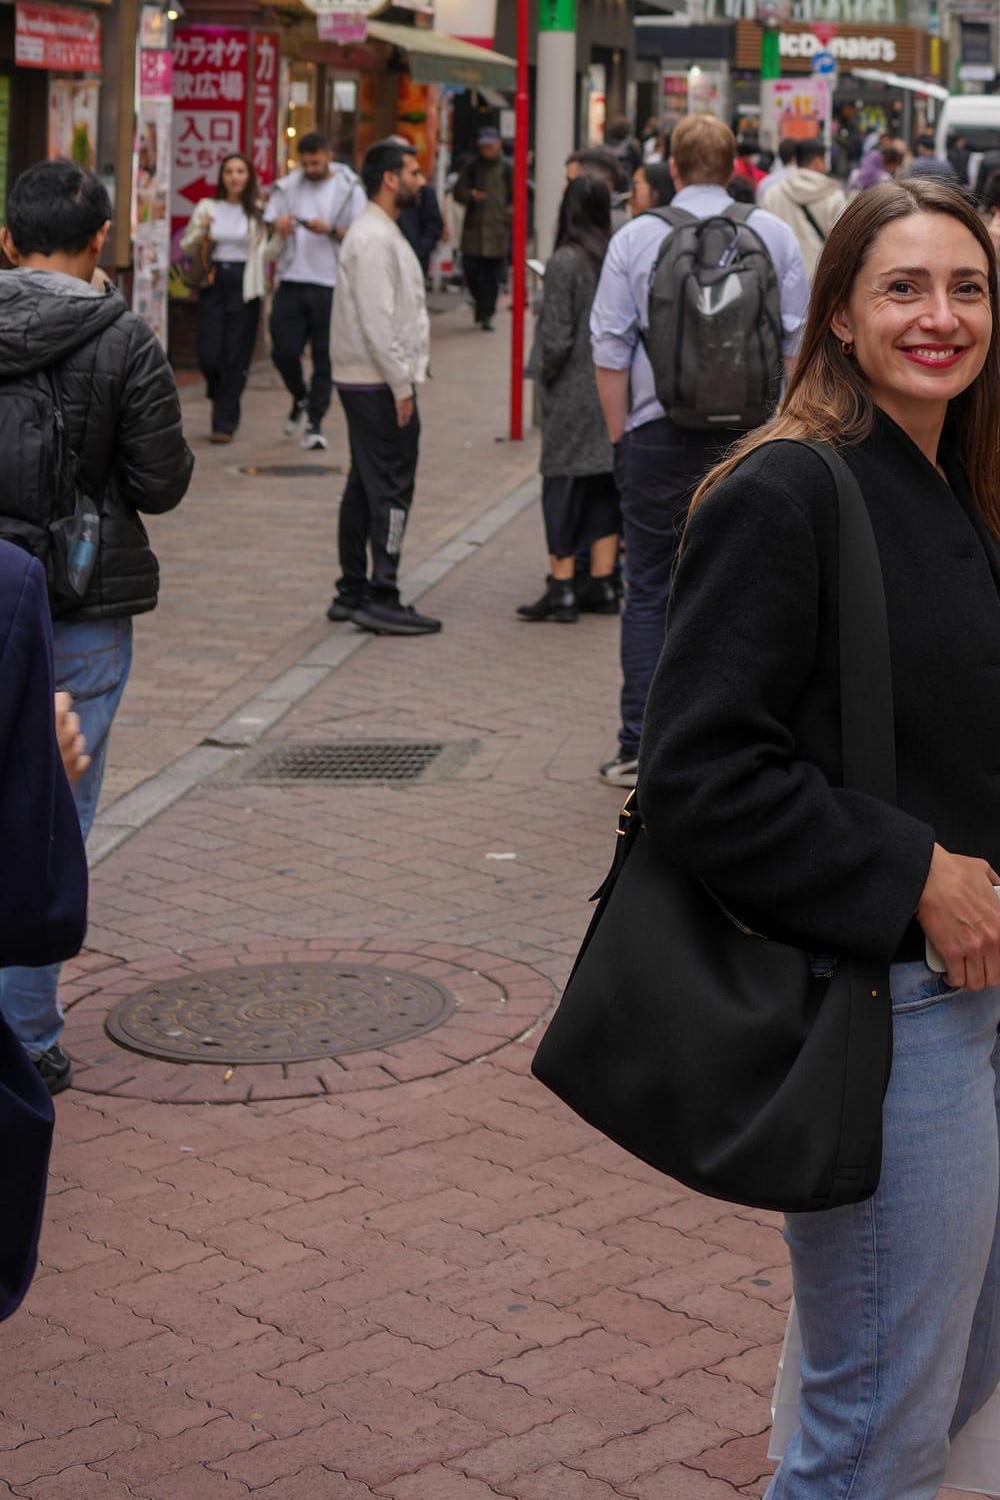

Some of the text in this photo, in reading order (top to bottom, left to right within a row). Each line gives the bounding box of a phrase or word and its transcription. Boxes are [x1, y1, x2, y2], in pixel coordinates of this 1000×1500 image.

[173, 35, 247, 68] カラオケ
[779, 32, 898, 62] cDnald's
[171, 70, 245, 103] 歌広場
[253, 36, 277, 182] カラオ
[177, 114, 234, 144] 入口
